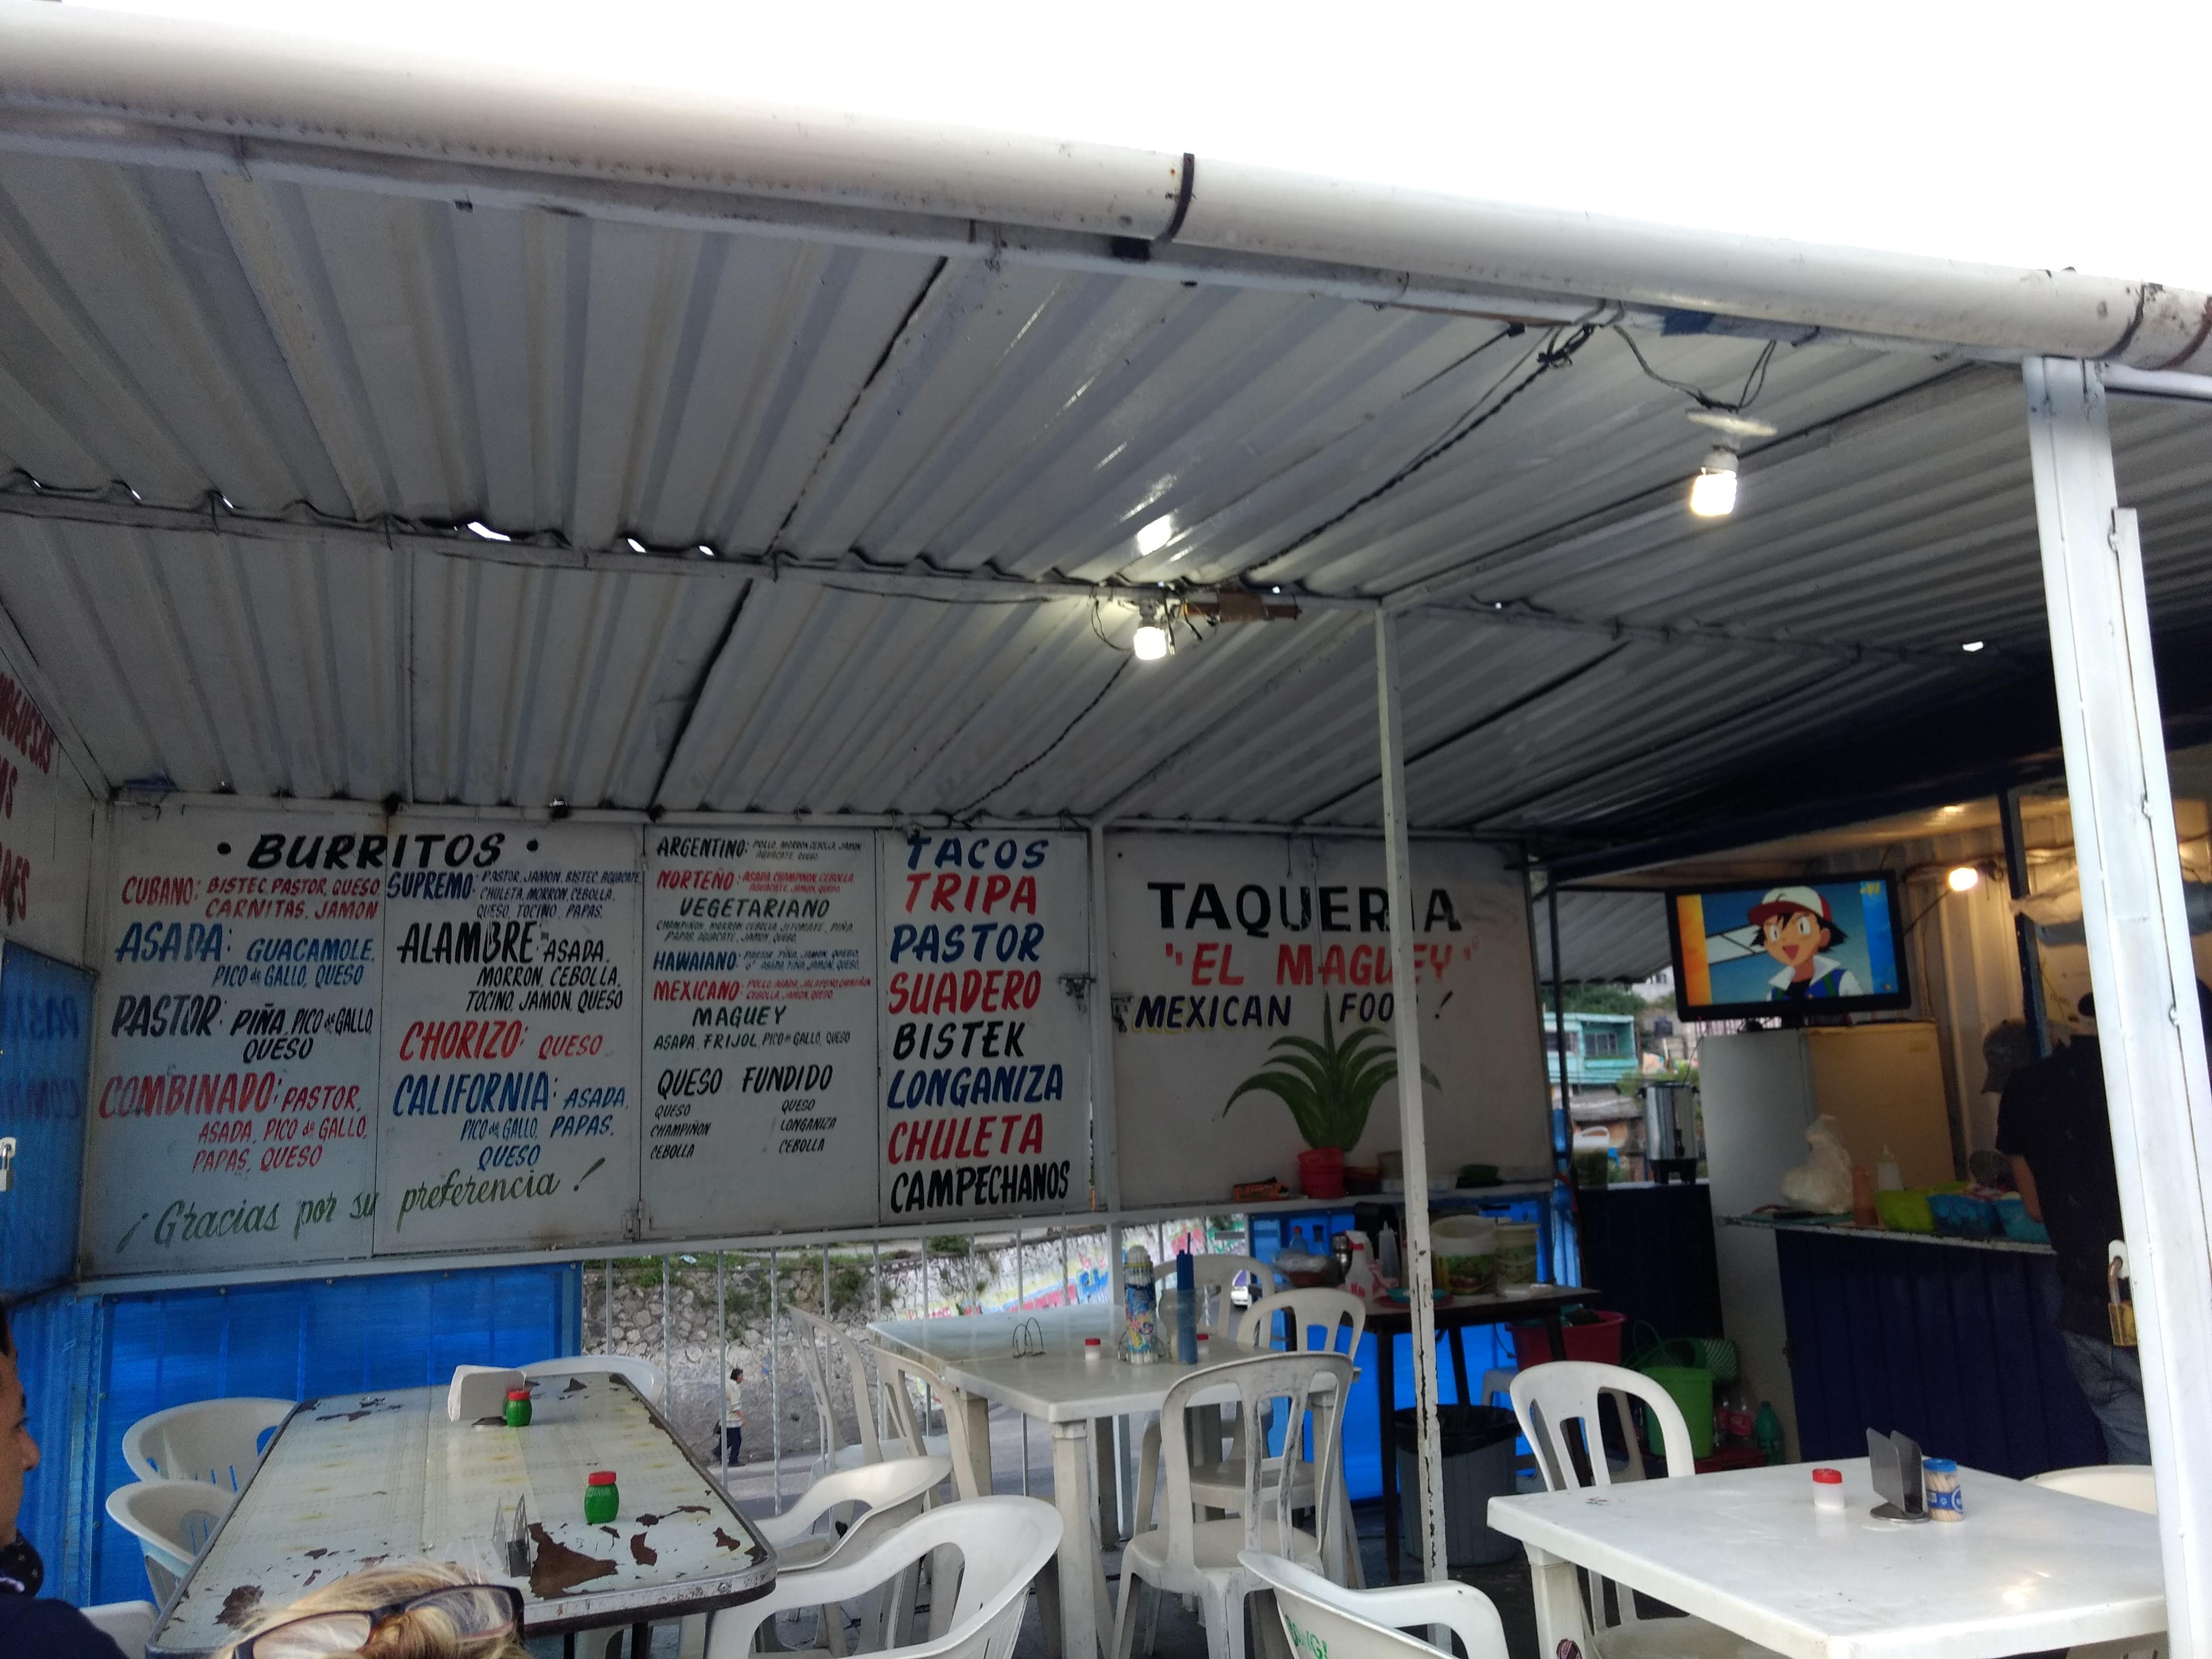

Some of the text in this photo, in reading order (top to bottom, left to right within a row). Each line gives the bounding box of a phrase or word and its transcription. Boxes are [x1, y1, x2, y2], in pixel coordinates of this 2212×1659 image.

[247, 833, 505, 869] BURRITOS
[908, 836, 1049, 870] TACOS
[905, 872, 1037, 915] TRIPA
[314, 900, 378, 920] JAMON
[680, 897, 830, 919] VEGETARIANO
[1147, 882, 1463, 938] TAQUERA
[890, 923, 1044, 964] PASTOR
[211, 964, 248, 988] PICO
[315, 964, 365, 988] QUESO
[577, 989, 624, 1014] QUESO
[888, 969, 1042, 1016] SUADERO
[290, 1007, 324, 1035] PICO
[692, 1005, 787, 1028] MAGUEY
[1133, 994, 1292, 1031] MEXICAN
[243, 1037, 314, 1064] QUESO
[538, 1034, 603, 1060] QUESO
[762, 1032, 784, 1047] PICO
[826, 1031, 851, 1046] QUESO
[893, 1020, 1026, 1060] BISTEK
[657, 1063, 833, 1100] QUESO FUNDIDO
[887, 1063, 1063, 1110] LONGANIZA
[654, 1098, 816, 1120] QUESO QUESO
[263, 1118, 299, 1142] PICO
[460, 1118, 488, 1141] PICO
[650, 1117, 837, 1137] CHAMPIÑON LONGANIZA
[887, 1112, 1044, 1165] CHULETA
[260, 1144, 323, 1172] QUESO
[478, 1144, 541, 1171] QUESO
[650, 1138, 826, 1160] CEBOLLA CEBOLLA
[890, 1160, 1070, 1214] CAMPECHANOS
[293, 1190, 337, 1241] por
[349, 1191, 379, 1220] su
